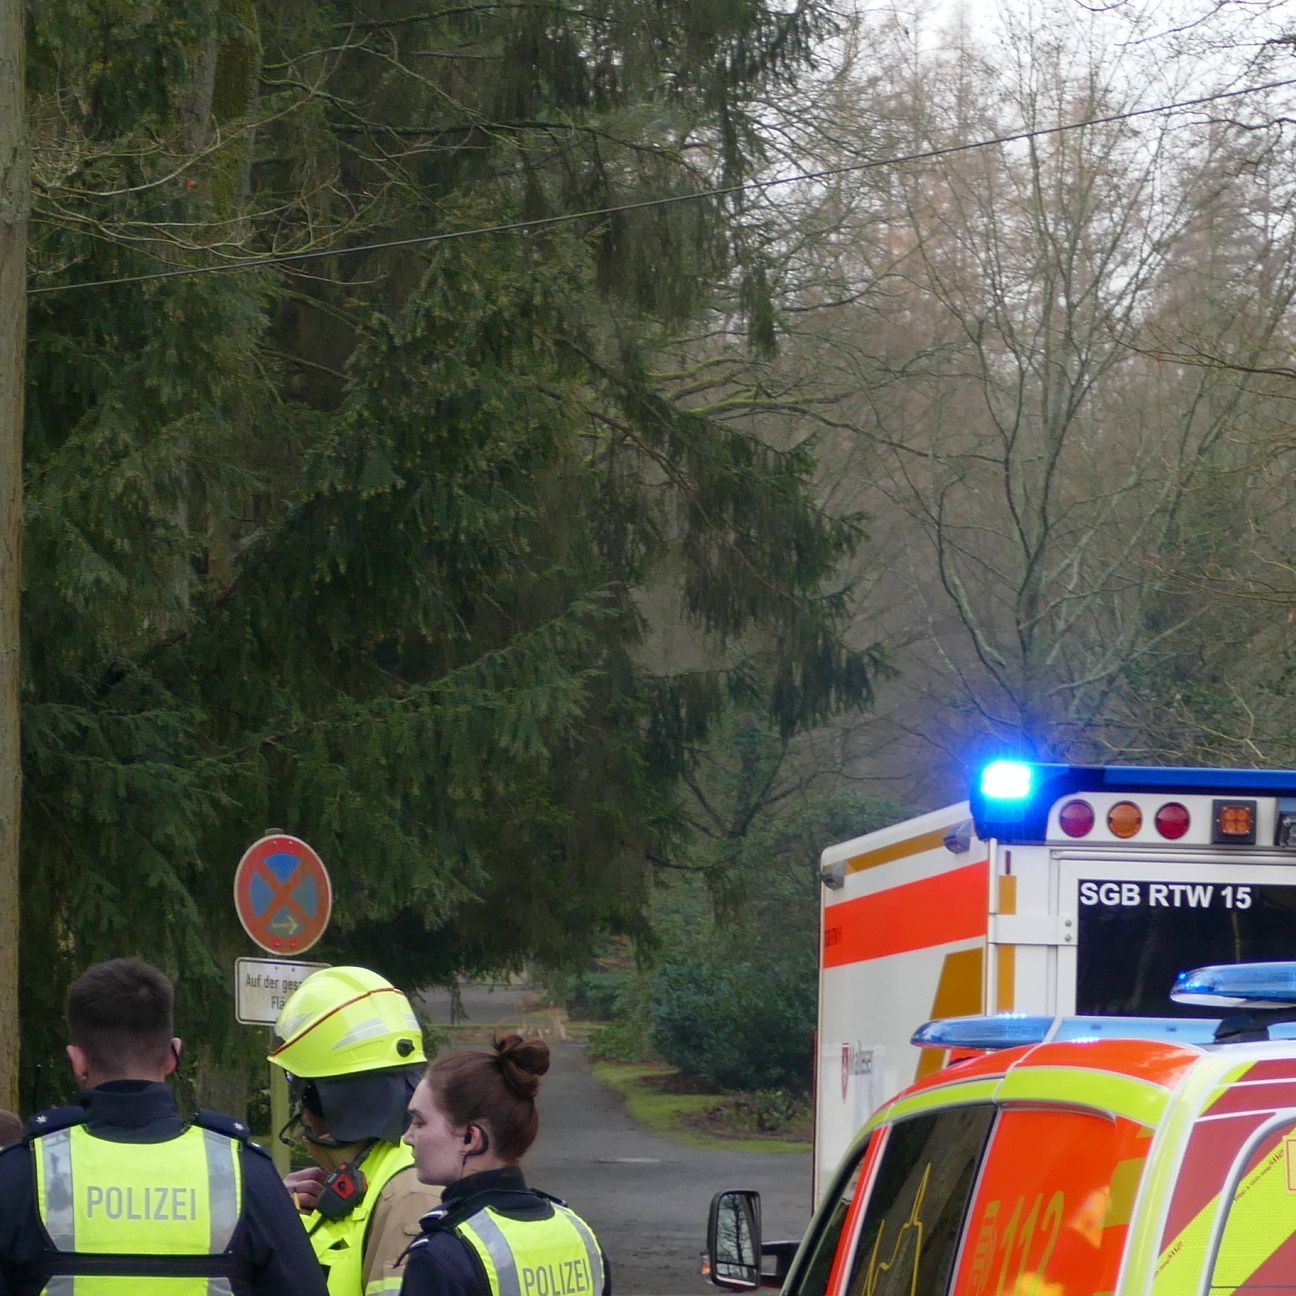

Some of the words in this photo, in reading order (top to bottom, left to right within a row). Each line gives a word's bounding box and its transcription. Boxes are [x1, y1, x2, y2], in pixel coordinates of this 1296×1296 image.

[1079, 882, 1141, 907] SGB
[1148, 884, 1214, 908] RTW
[1221, 886, 1252, 909] 15
[245, 973, 262, 987] Auf
[264, 974, 279, 989] der
[85, 1185, 197, 1222] POLIZEI
